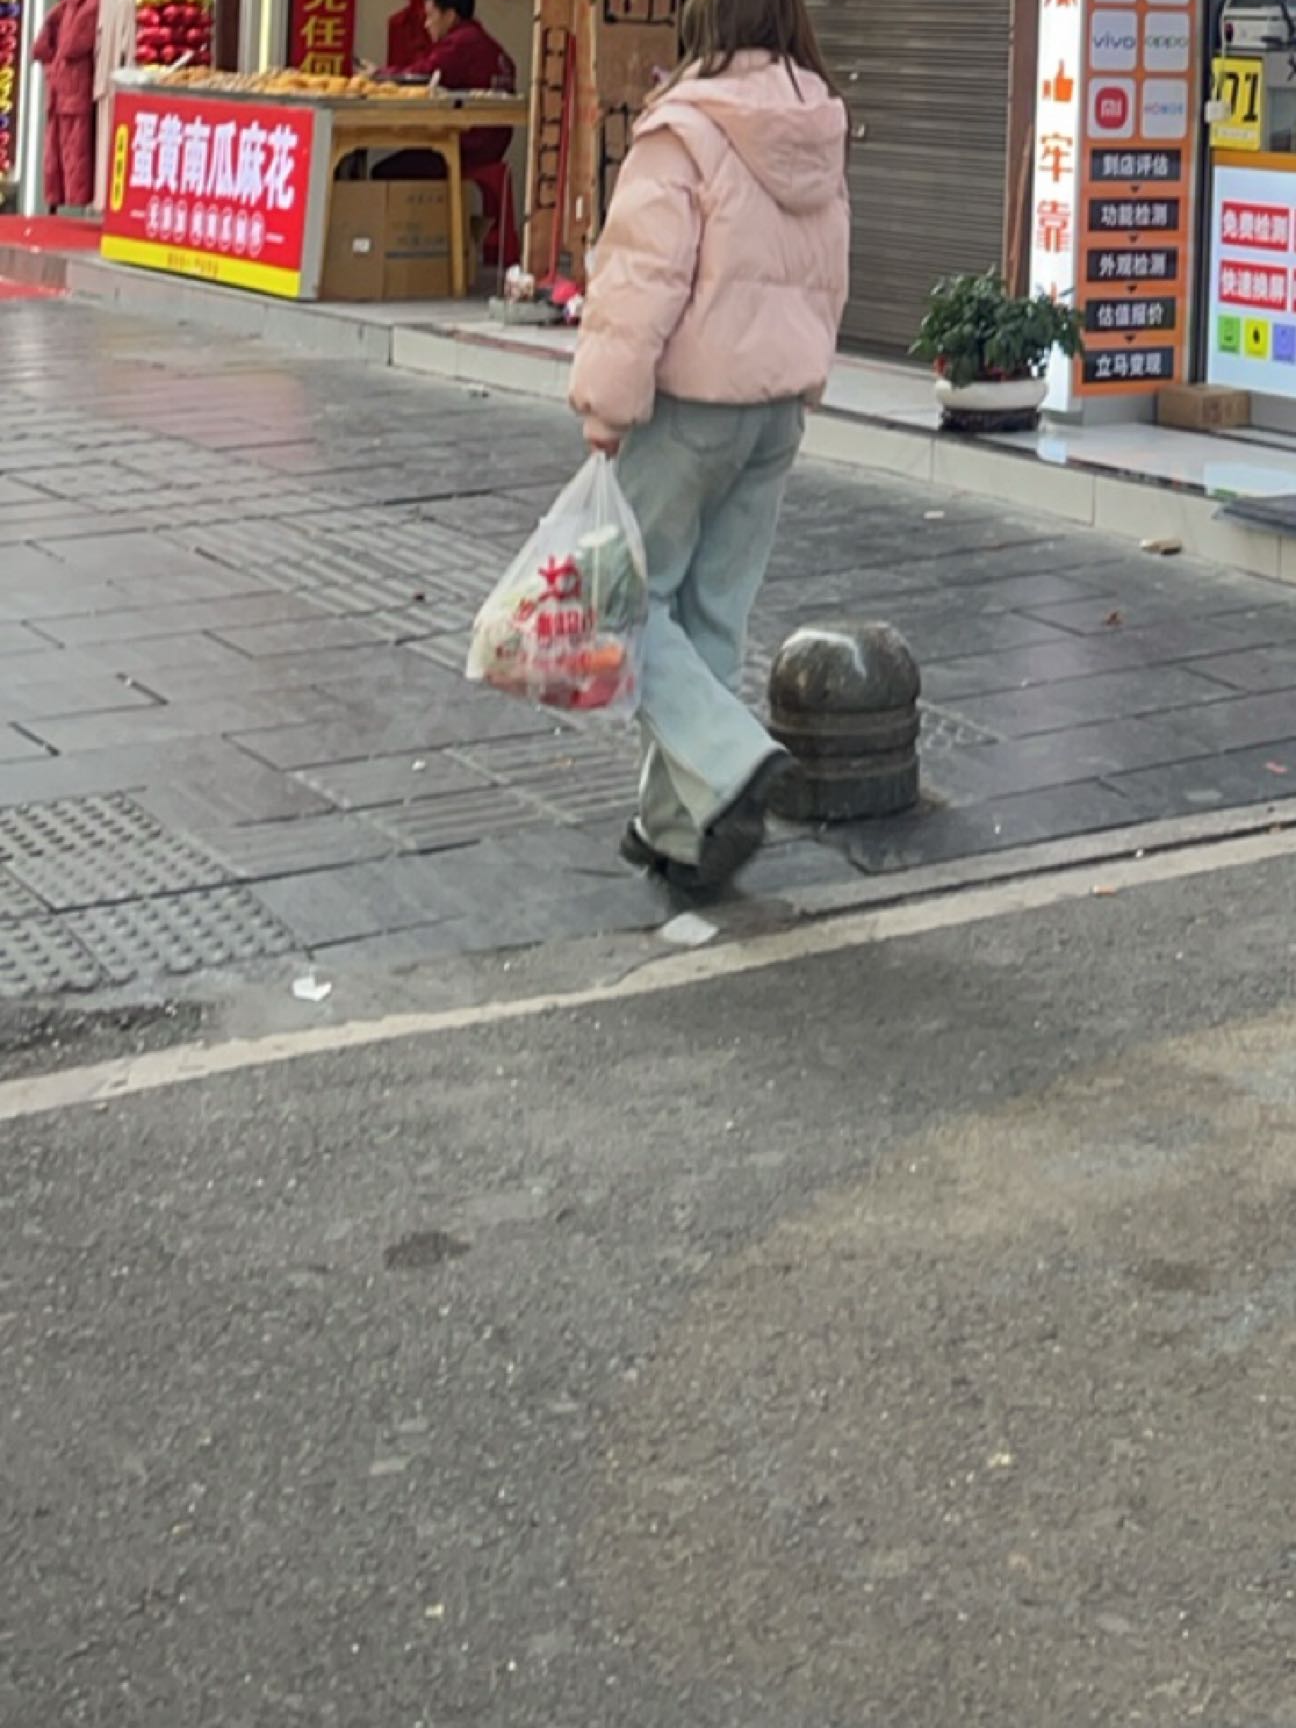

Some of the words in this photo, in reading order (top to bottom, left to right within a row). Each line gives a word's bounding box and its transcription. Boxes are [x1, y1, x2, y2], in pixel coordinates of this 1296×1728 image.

[1093, 32, 1135, 50] vivo
[129, 112, 298, 210] 蛋黄南瓜麻花
[1102, 152, 1169, 177] 到店评估
[1100, 203, 1168, 227] 功能检测
[1223, 208, 1288, 243] 免费检测
[1098, 253, 1167, 277] 外观检测
[1097, 304, 1164, 327] 估值报价
[1095, 352, 1162, 378] 立马变现
